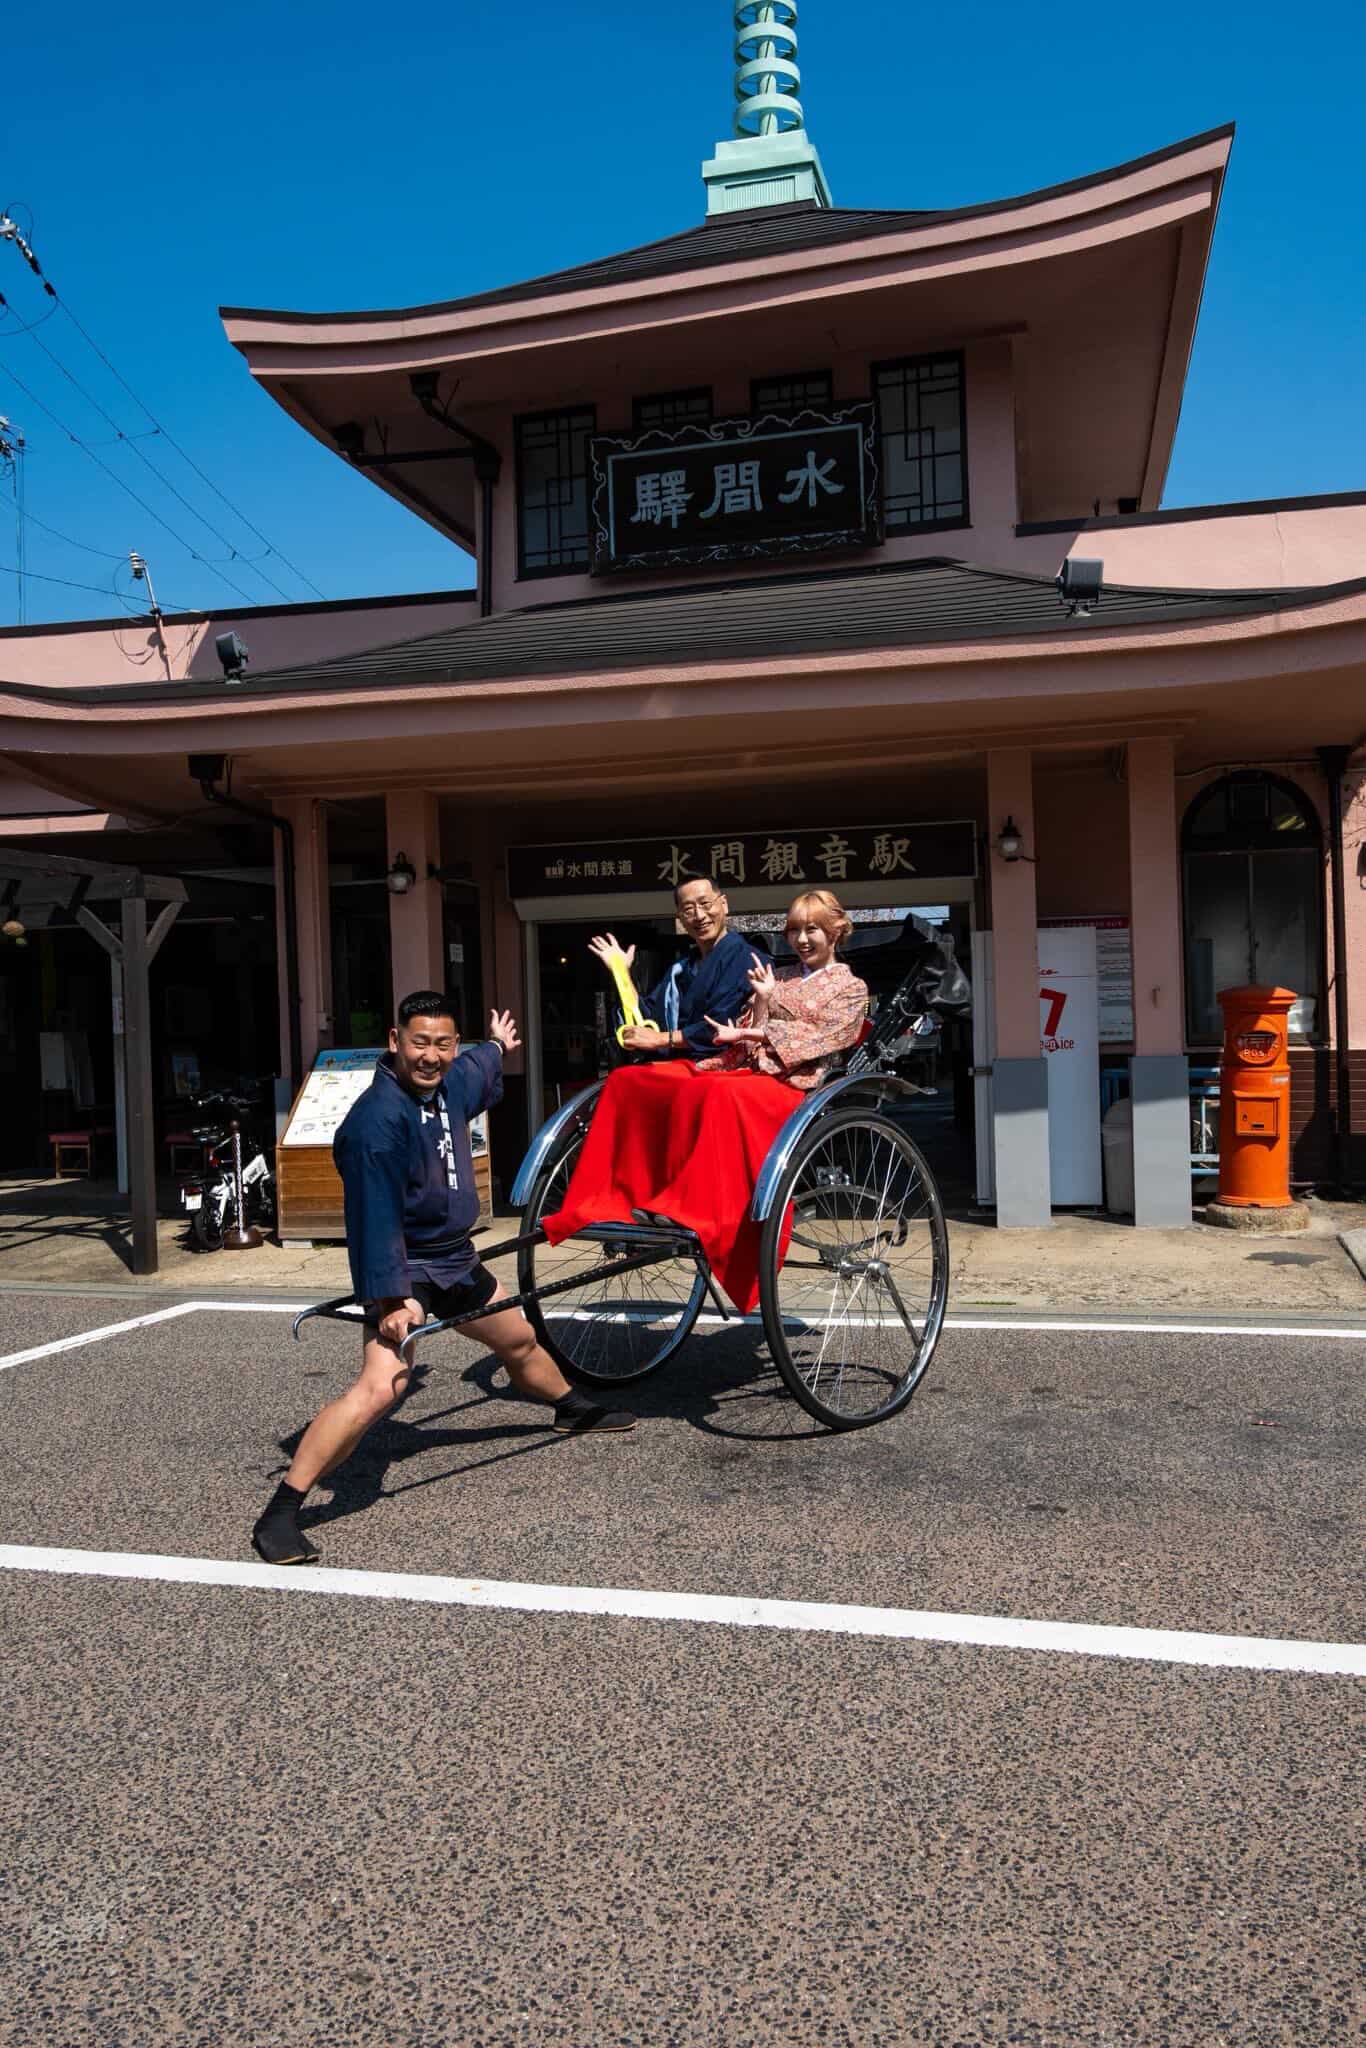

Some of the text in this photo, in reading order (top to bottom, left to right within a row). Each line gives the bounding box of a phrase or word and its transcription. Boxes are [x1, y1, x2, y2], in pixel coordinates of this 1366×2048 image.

[656, 832, 917, 887] 水間観音駅
